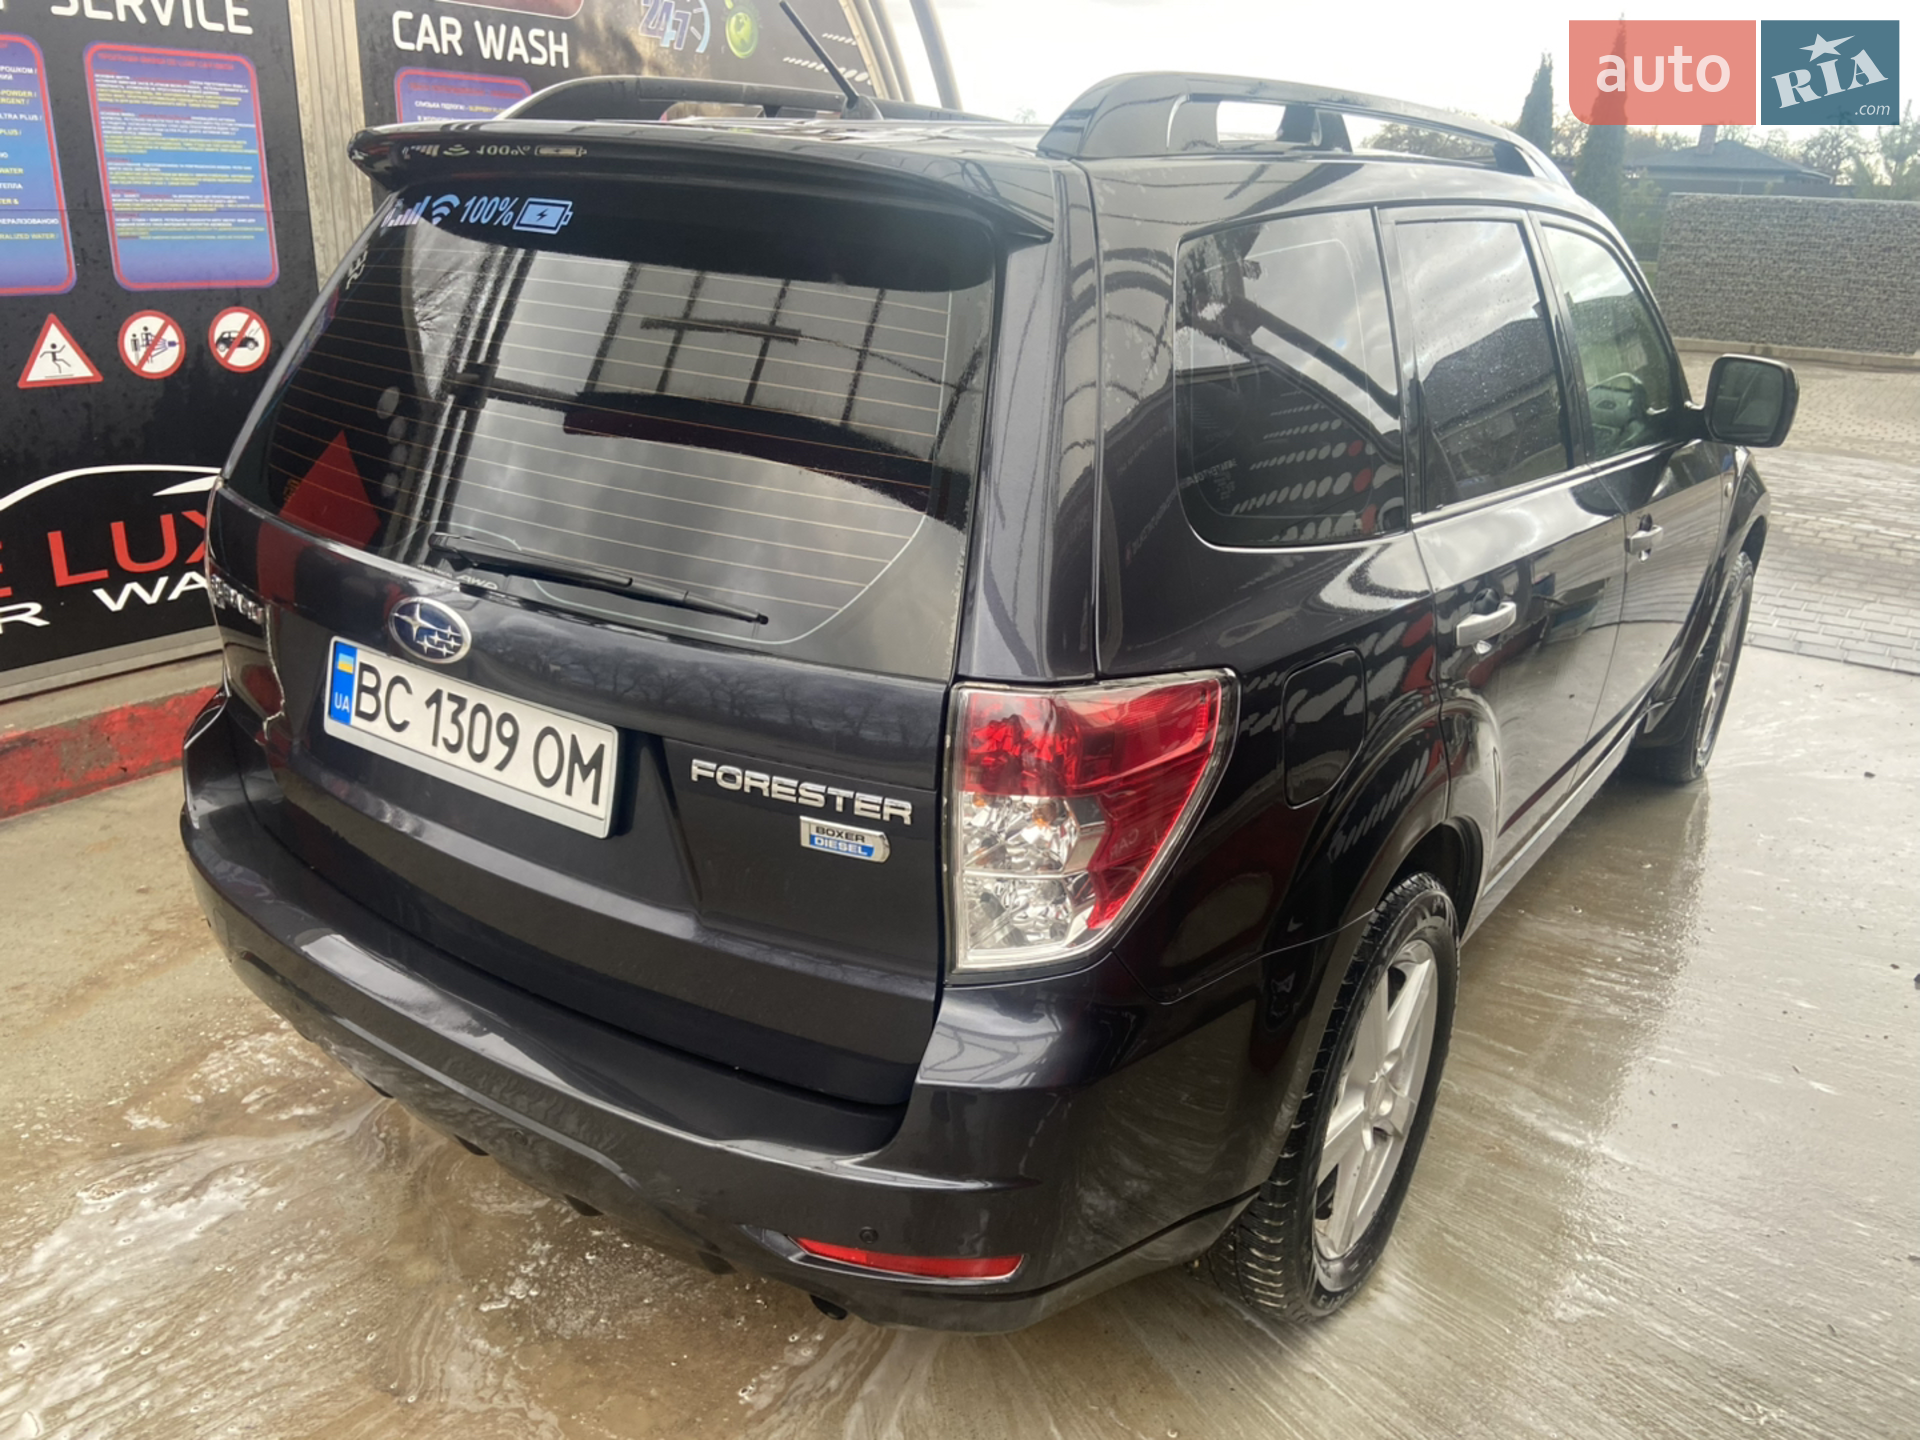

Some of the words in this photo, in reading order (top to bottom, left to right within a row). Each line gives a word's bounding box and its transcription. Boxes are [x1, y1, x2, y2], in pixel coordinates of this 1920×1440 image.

[392, 10, 463, 57] CAR
[474, 20, 569, 68] WASH
[460, 196, 519, 226] 100%
[334, 691, 350, 713] UA
[354, 662, 413, 732] BC
[425, 688, 519, 772] 1309
[533, 726, 605, 806] OM
[691, 758, 912, 825] FORESTER
[814, 836, 868, 856] DIESEL
[815, 826, 865, 844] BOXER
